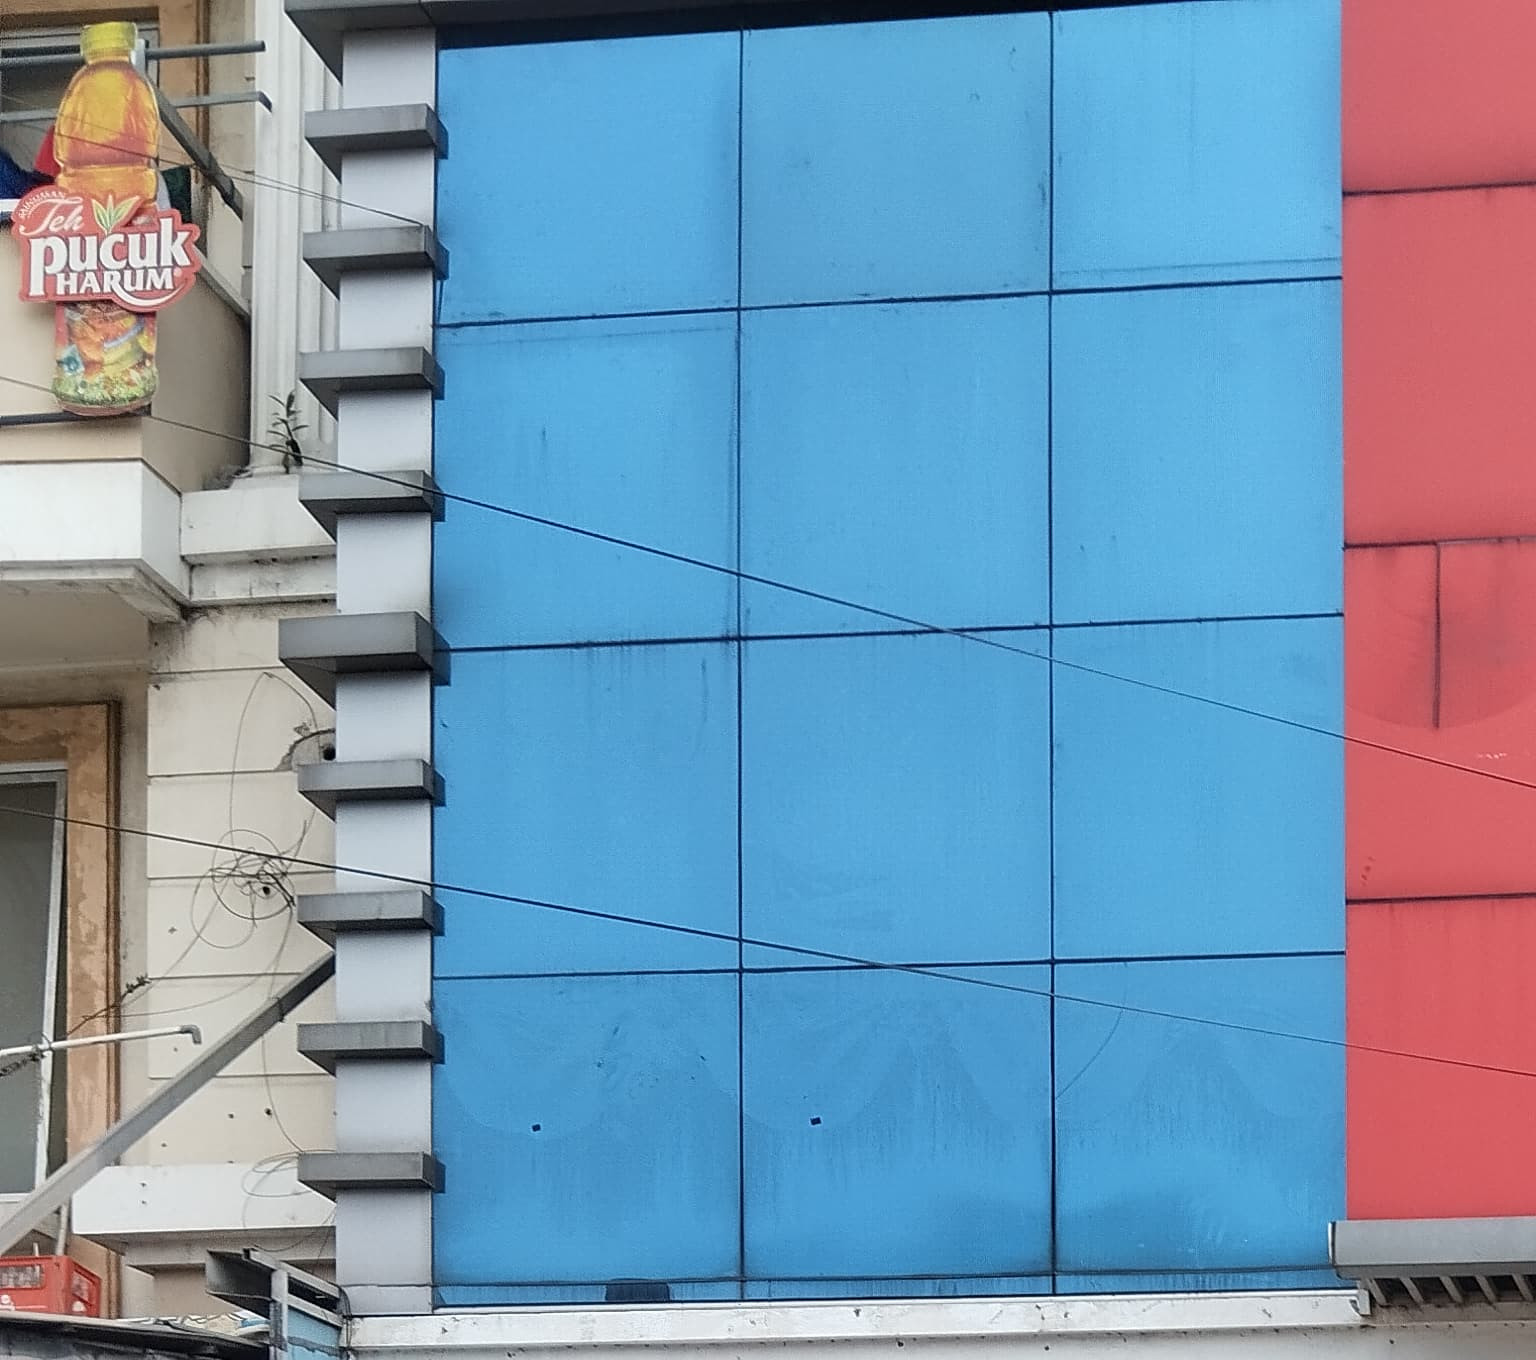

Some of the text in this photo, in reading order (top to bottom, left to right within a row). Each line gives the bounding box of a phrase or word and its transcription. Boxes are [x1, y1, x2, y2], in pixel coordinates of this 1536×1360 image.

[19, 196, 84, 236] Teh
[29, 218, 191, 296] pucuk
[56, 268, 174, 296] HARUM
